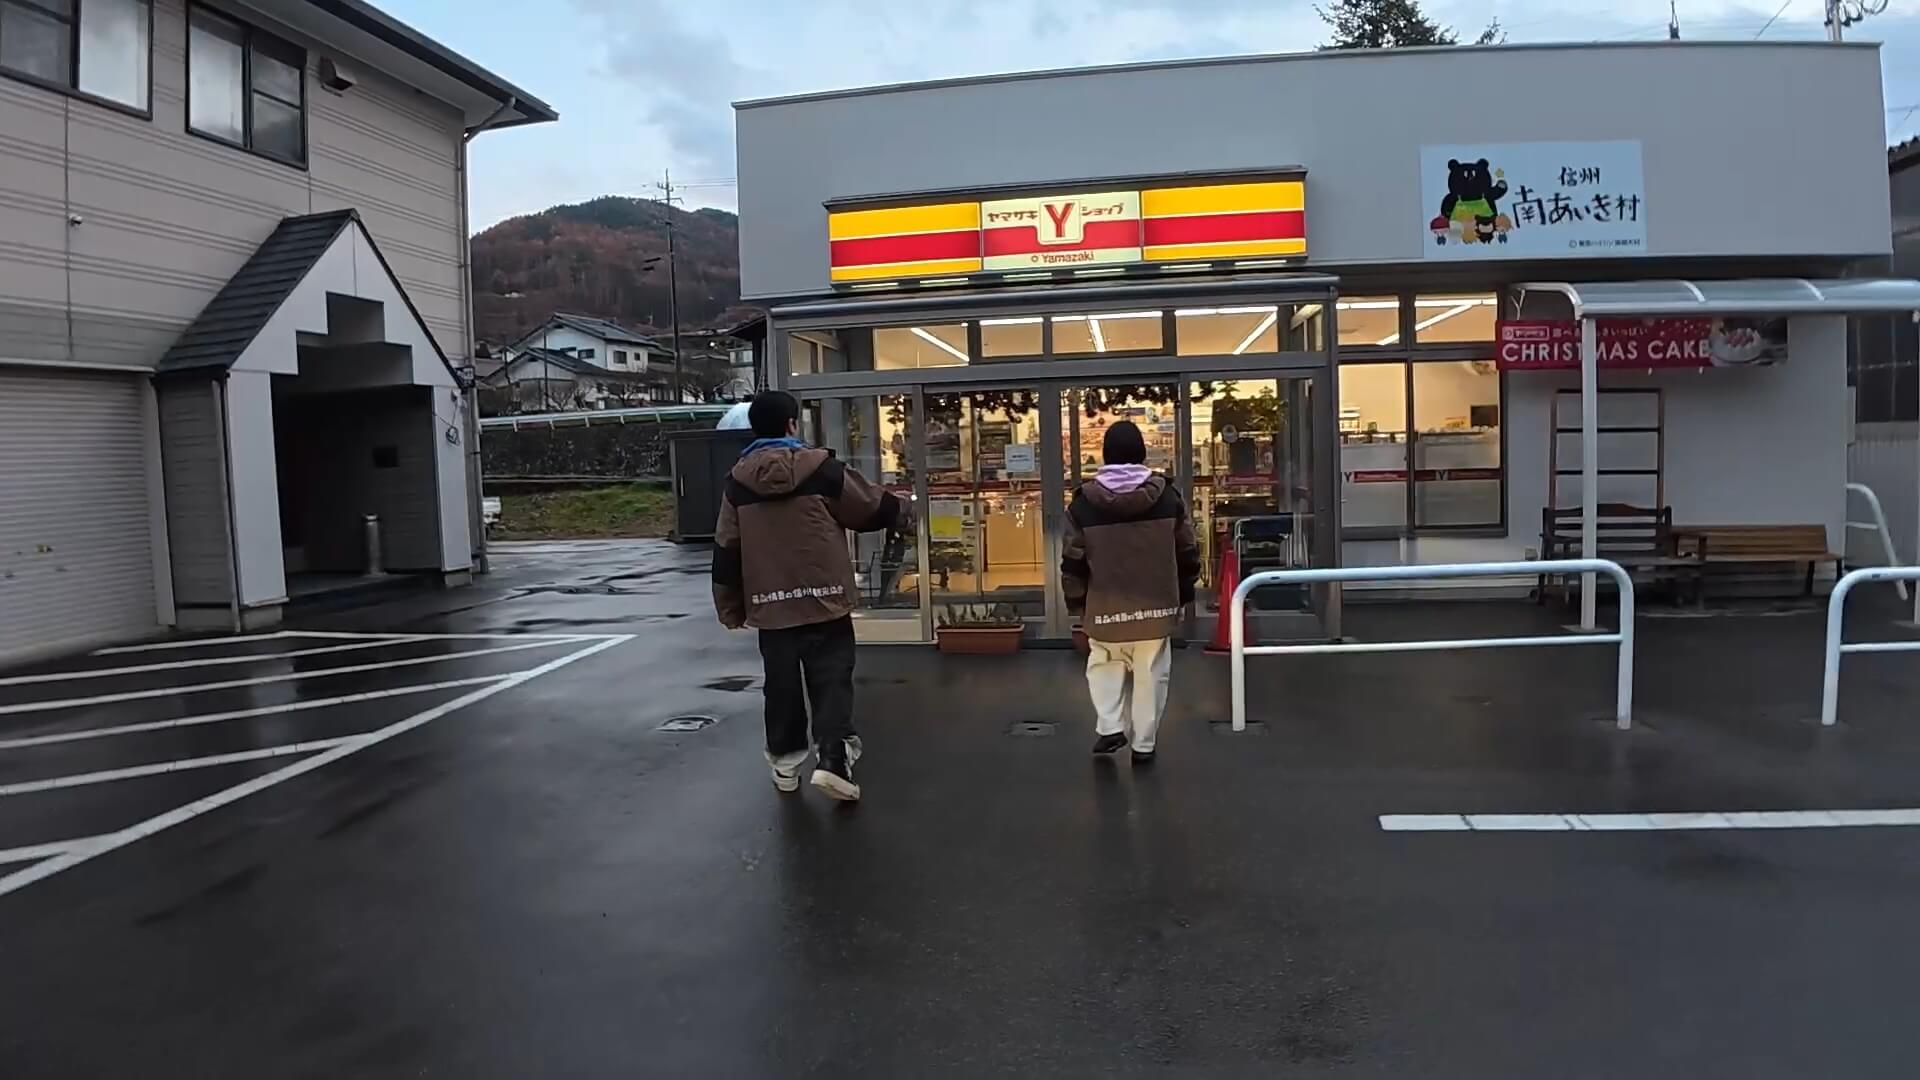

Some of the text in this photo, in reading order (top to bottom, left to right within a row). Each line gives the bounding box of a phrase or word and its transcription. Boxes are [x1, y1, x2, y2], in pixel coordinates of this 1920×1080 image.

[1558, 166, 1601, 186] 信州
[1512, 184, 1641, 229] 南あいき村
[1044, 202, 1076, 238] Y
[1042, 251, 1094, 264] Yamazaki
[1648, 339, 1711, 360] CAKE
